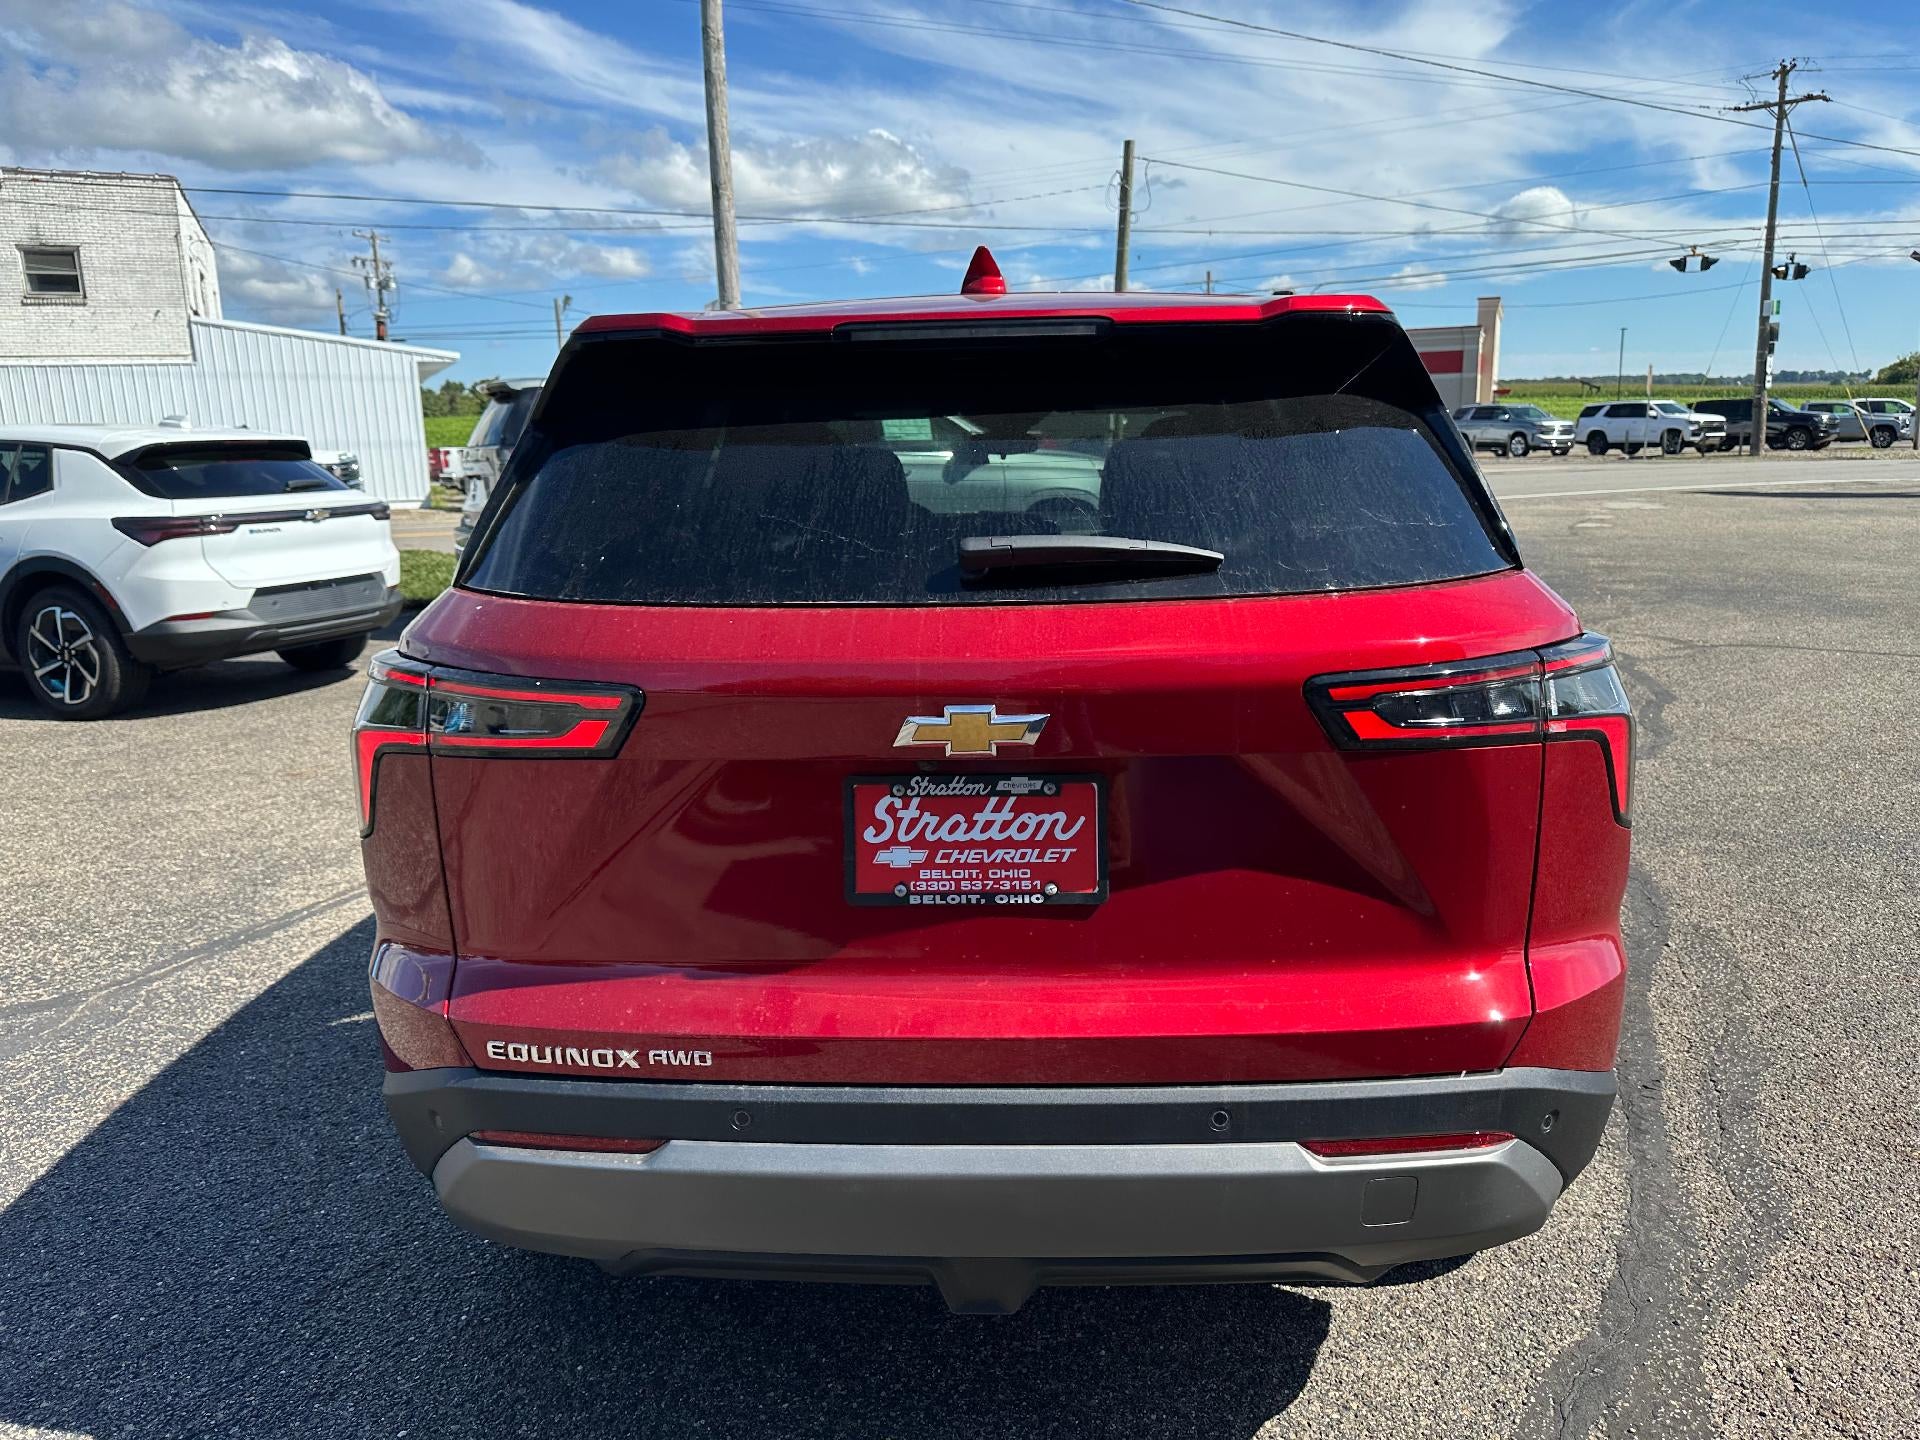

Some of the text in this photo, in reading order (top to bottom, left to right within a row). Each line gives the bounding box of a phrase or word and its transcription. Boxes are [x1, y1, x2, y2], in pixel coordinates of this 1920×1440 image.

[907, 776, 992, 796] Stratton
[863, 795, 1086, 844] Stratton
[934, 848, 1077, 864] CHEVROLET
[919, 869, 1031, 880] BELOIT, OHIO
[910, 880, 1041, 891] (330) 537-3151
[909, 894, 1045, 905] BELOIT, OHIO
[486, 1040, 713, 1069] EQUINOX AWD
